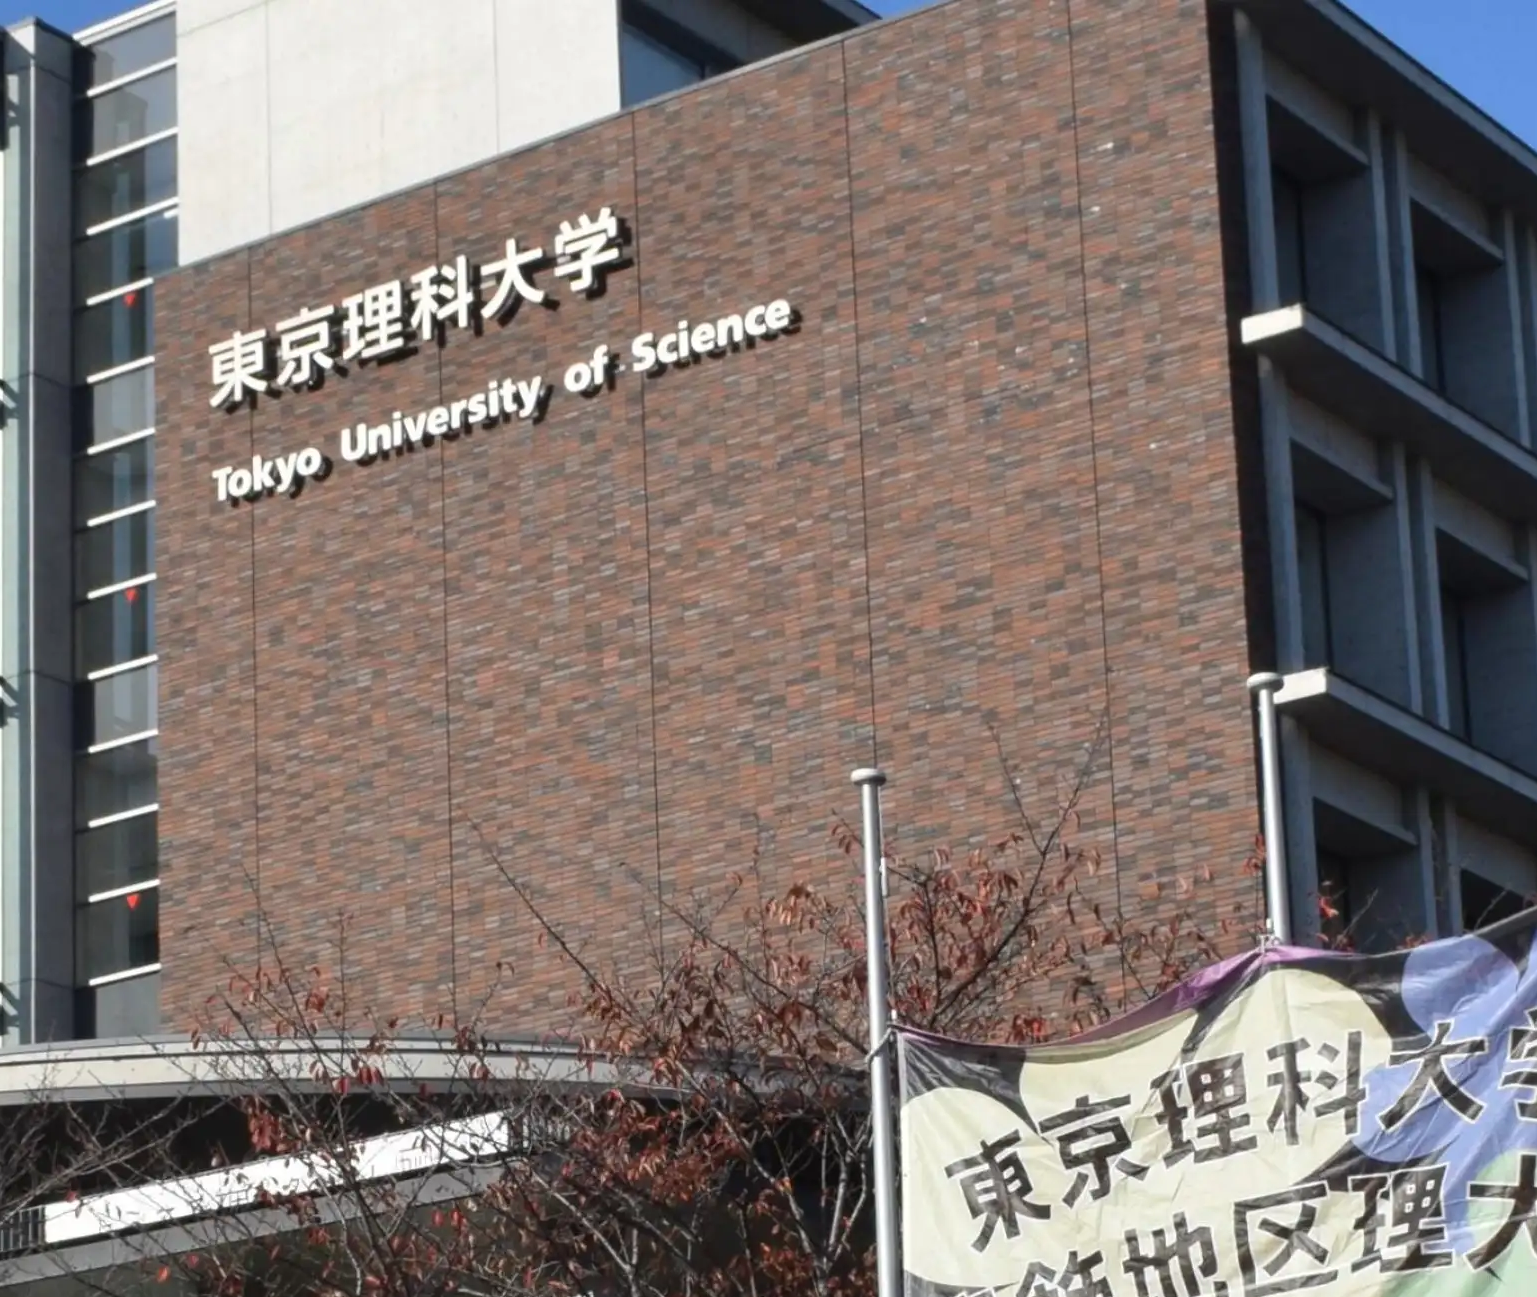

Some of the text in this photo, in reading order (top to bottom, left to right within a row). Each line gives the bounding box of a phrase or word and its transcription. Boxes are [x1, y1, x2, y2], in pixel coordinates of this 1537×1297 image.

[208, 207, 621, 408] 東京理科大学
[212, 298, 791, 502] Tokyo University of Science
